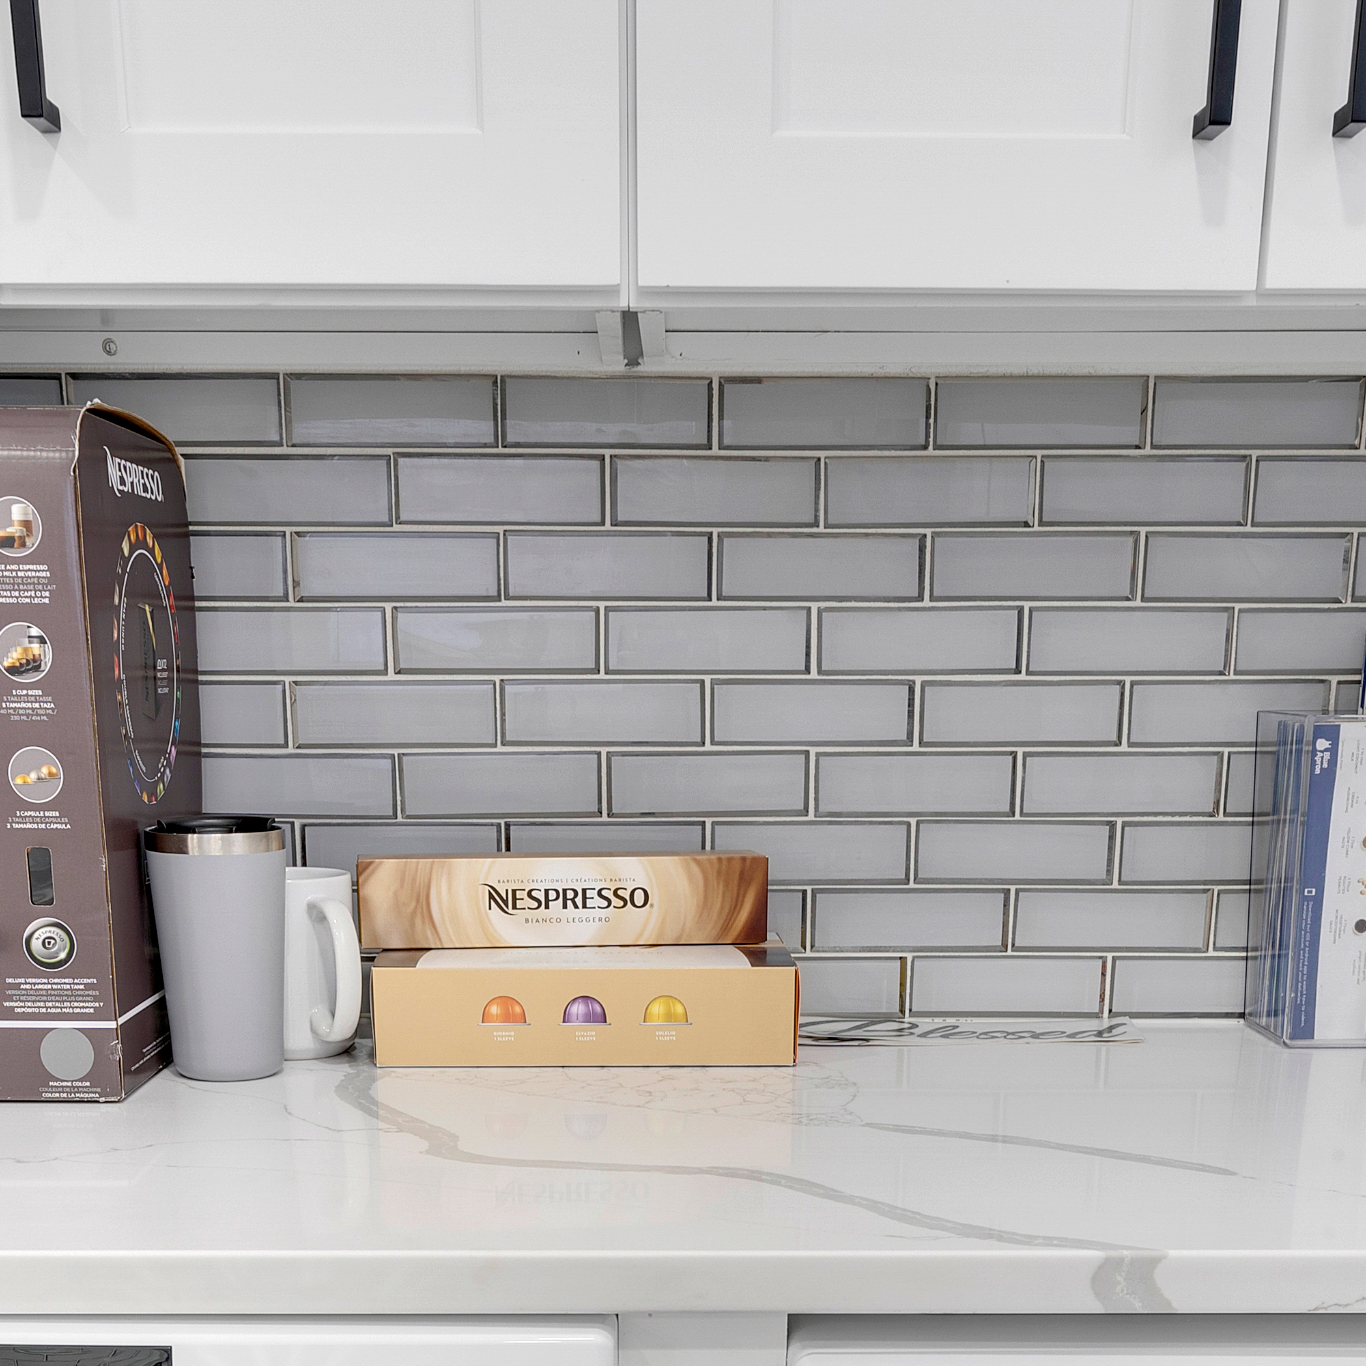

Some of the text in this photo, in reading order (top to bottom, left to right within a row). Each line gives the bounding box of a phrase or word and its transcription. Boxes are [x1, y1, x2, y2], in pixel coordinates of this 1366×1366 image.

[103, 446, 162, 502] NESPRESSO
[1315, 752, 1323, 774] Apron
[1323, 751, 1331, 768] Blue
[479, 883, 650, 915] NESPRESSO
[35, 930, 64, 942] NESPRESSO
[798, 1019, 1127, 1040] Blessed
